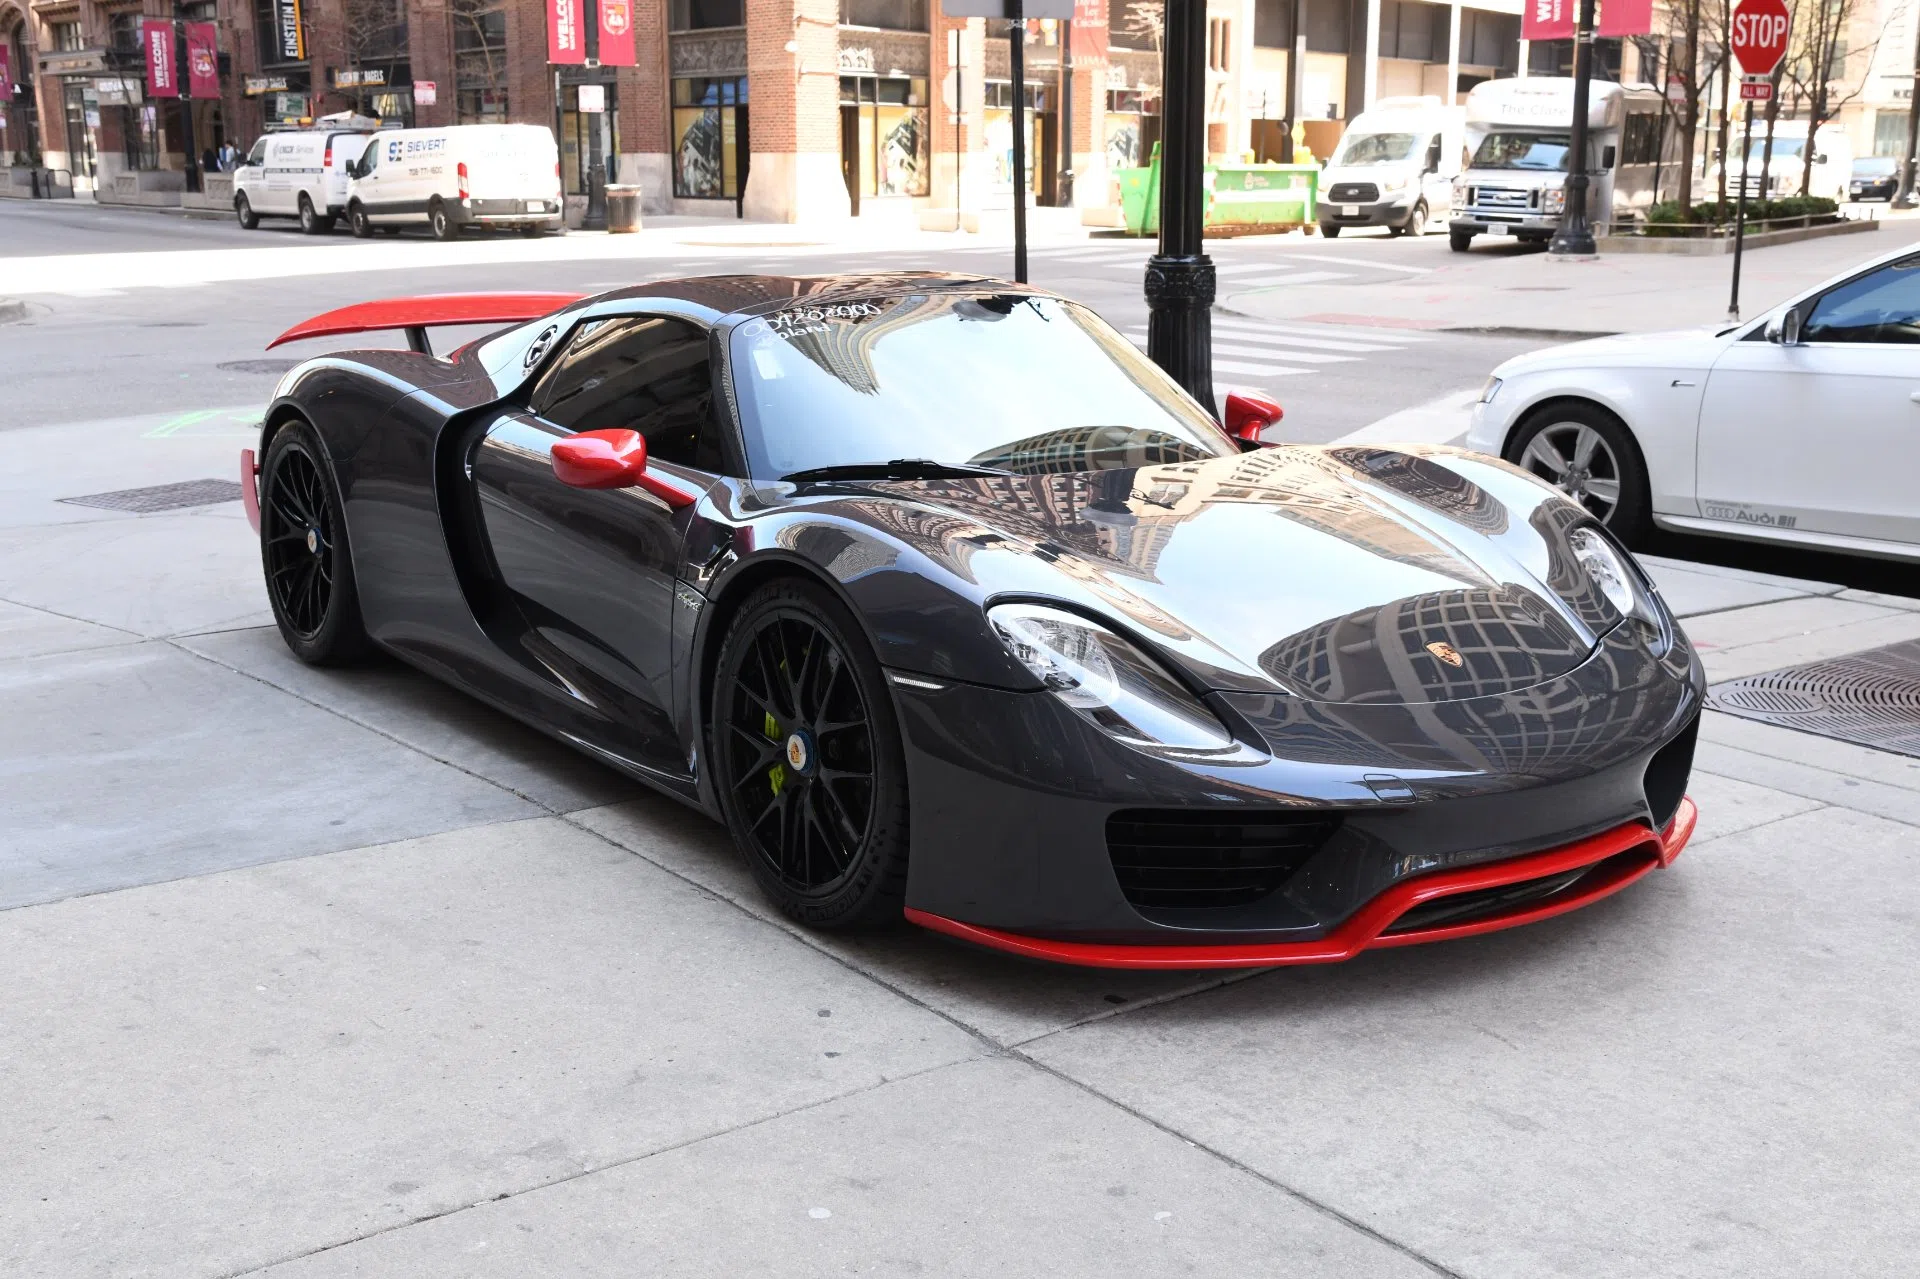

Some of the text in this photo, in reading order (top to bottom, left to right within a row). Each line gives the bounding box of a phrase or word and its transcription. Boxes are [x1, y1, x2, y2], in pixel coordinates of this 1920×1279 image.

[281, 5, 299, 57] EINSTEIN
[1734, 13, 1786, 48] STOP
[151, 31, 165, 88] WELCOME
[1071, 55, 1109, 66] LUMA
[364, 70, 384, 81] BAGELS
[1742, 87, 1754, 97] ALL
[1755, 86, 1769, 97] WAY
[1501, 104, 1525, 115] The
[407, 138, 447, 152] SIEVERT
[1736, 510, 1776, 525] Audi
